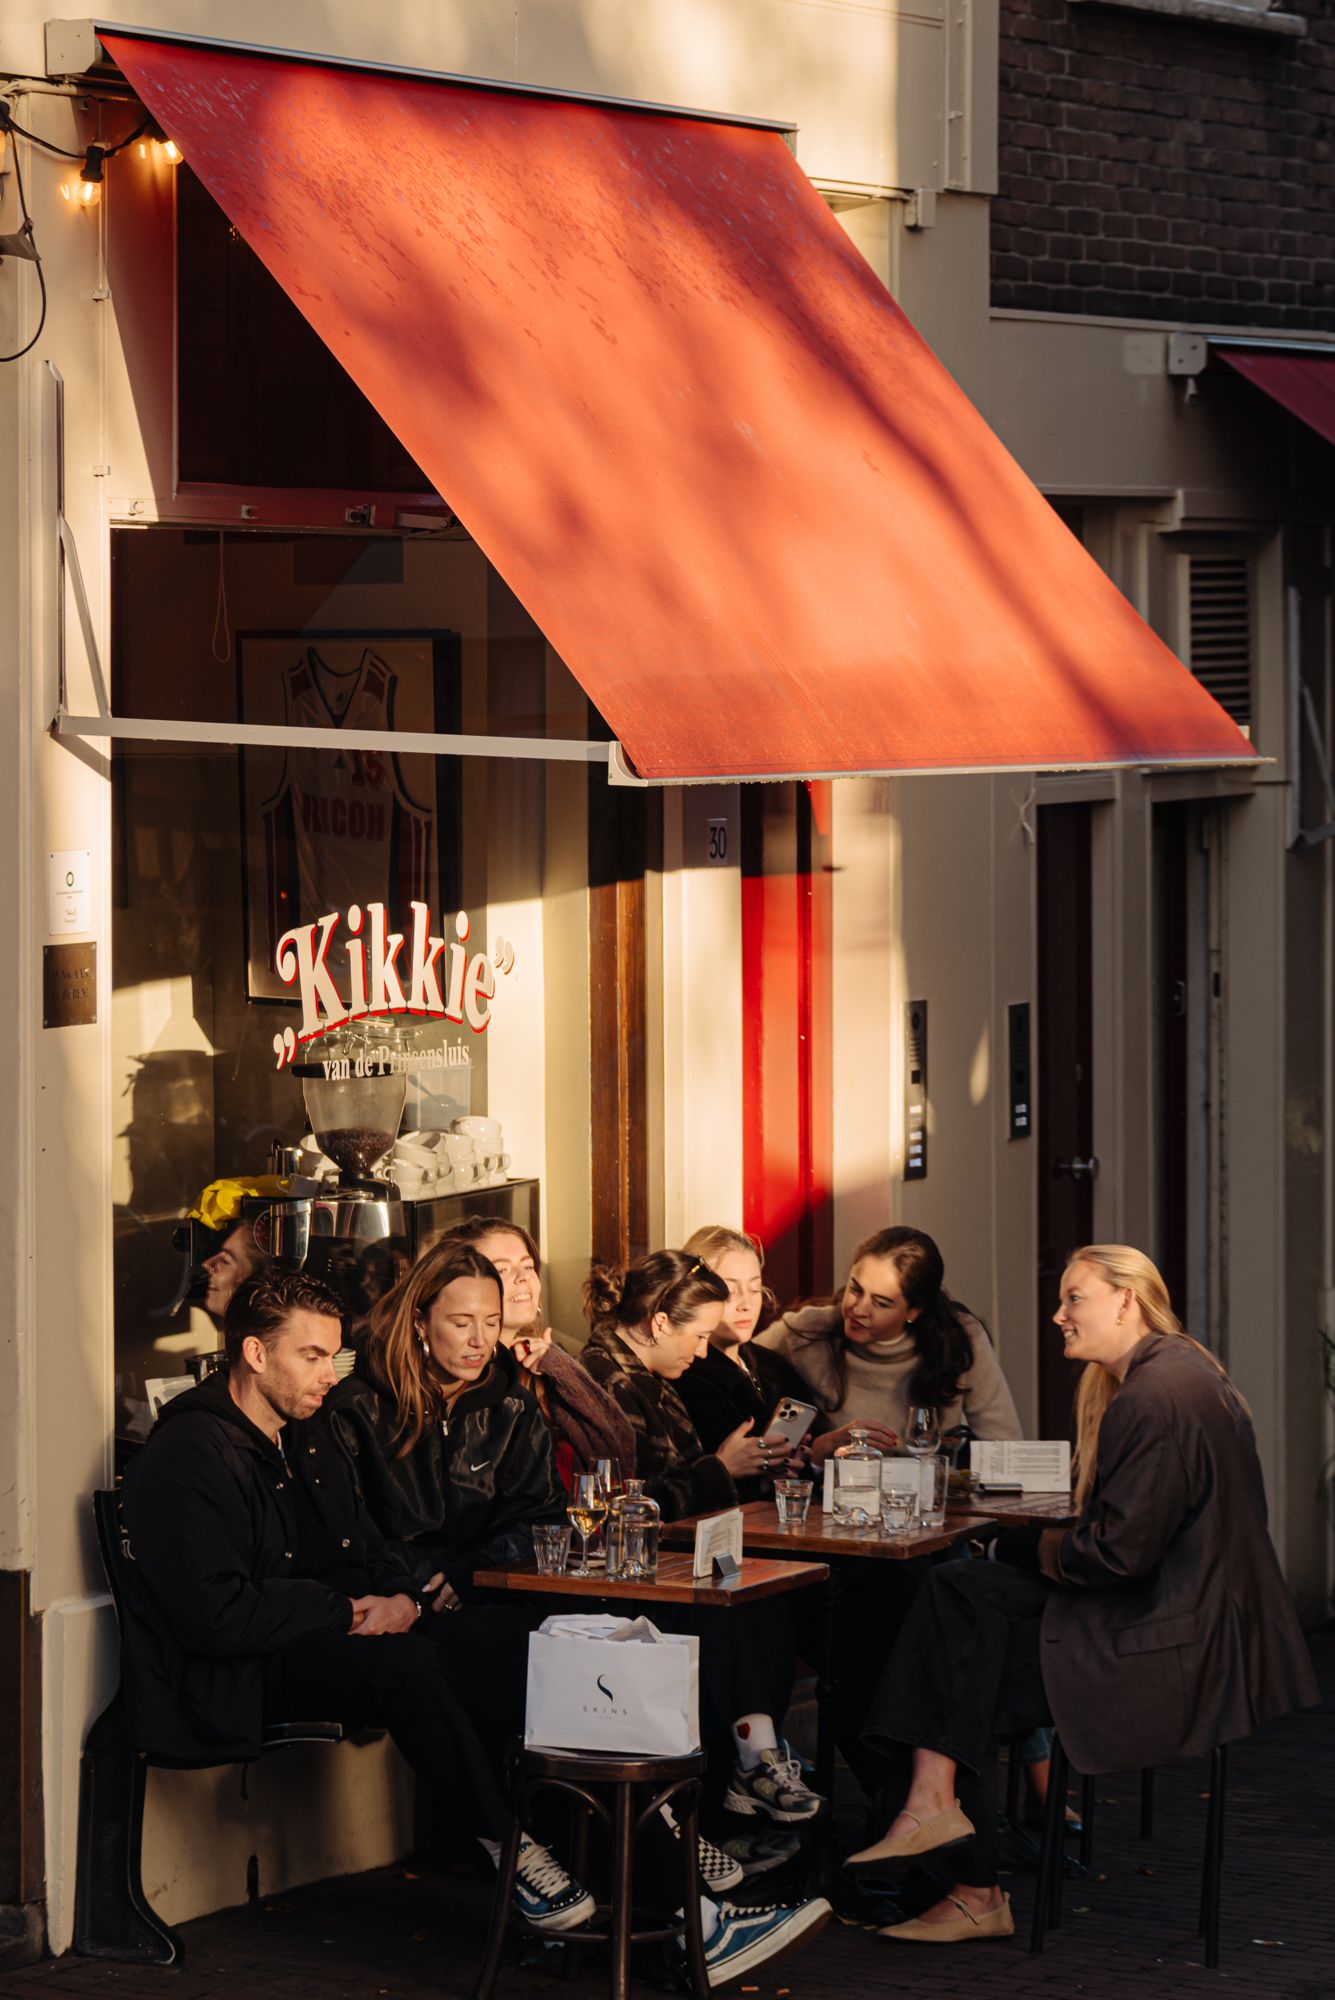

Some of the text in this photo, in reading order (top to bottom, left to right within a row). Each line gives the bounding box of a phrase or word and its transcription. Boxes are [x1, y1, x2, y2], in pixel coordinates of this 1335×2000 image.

[709, 826, 727, 859] 30
[322, 1059, 350, 1082] van
[354, 1050, 373, 1078] de
[582, 1705, 628, 1716] SKINS
